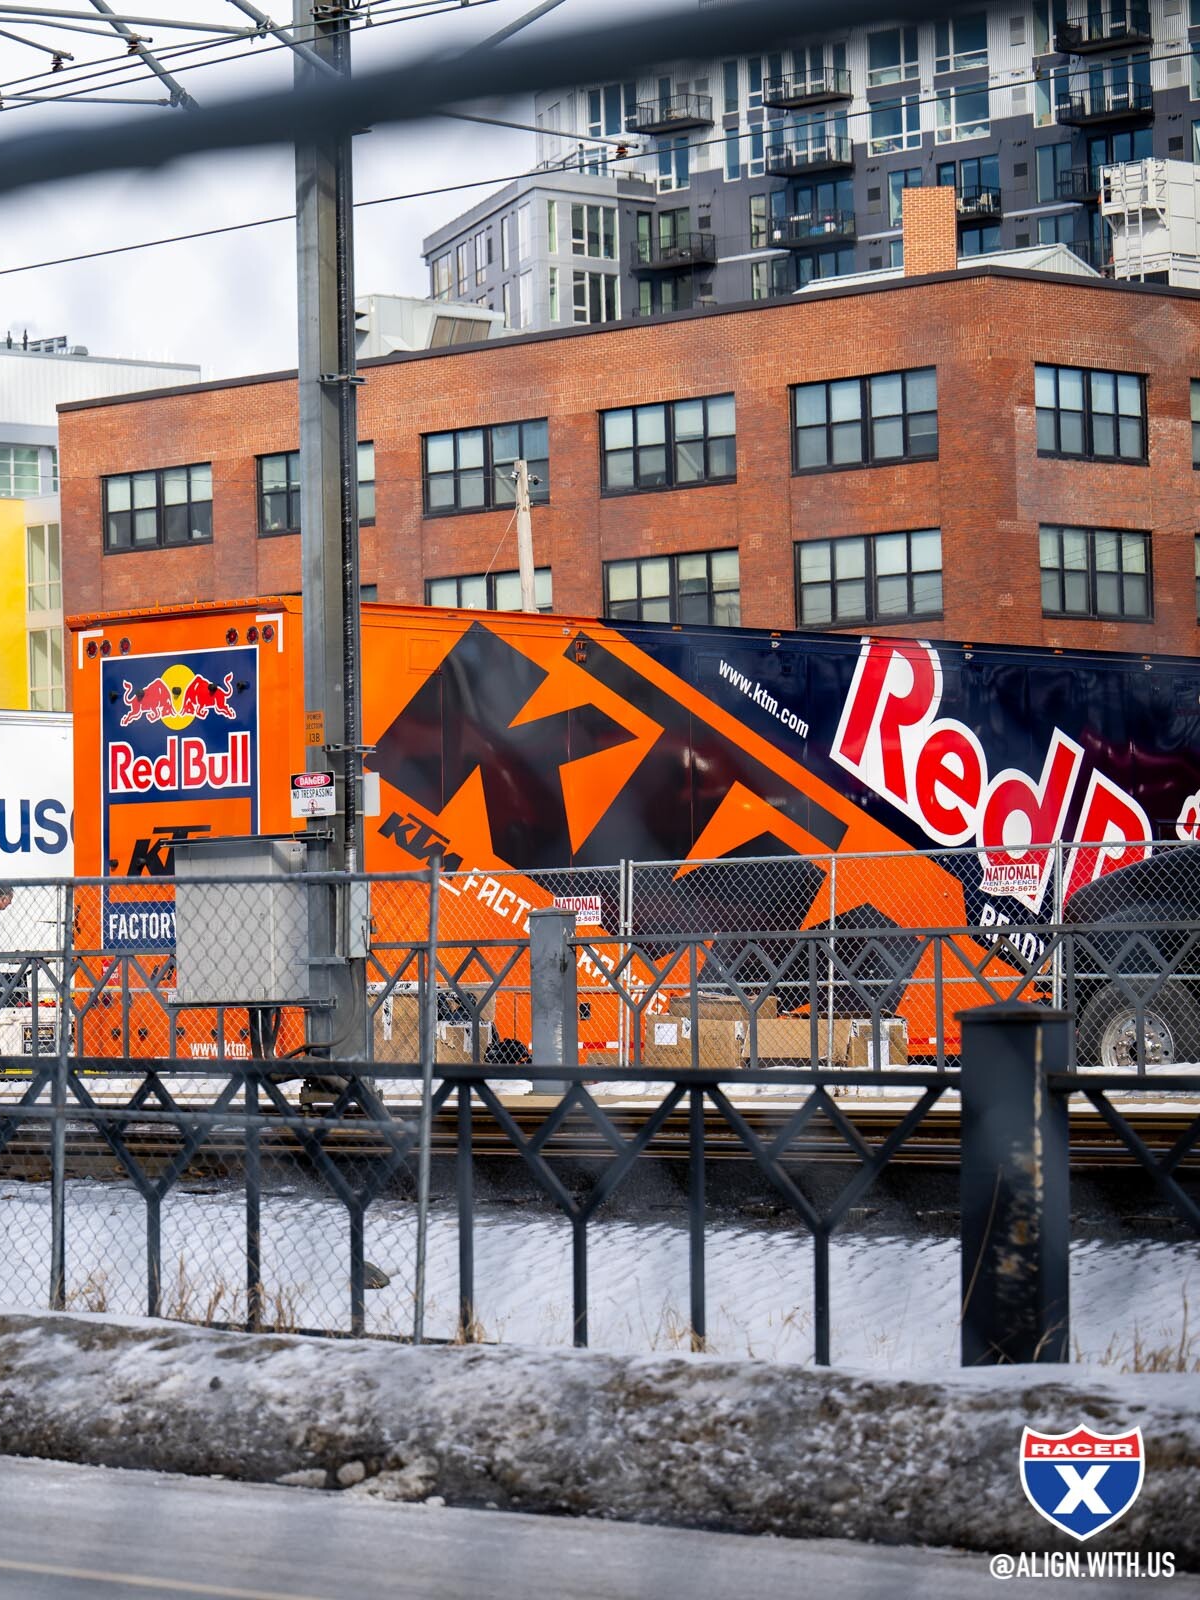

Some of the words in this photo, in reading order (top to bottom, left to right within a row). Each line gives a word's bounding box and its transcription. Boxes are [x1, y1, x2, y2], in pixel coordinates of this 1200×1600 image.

[719, 660, 809, 739] www.ktm.com
[309, 733, 320, 742] 13B
[109, 736, 178, 793] Red
[181, 731, 251, 790] Bull
[299, 776, 325, 786] DANGER
[293, 790, 300, 799] NO
[301, 787, 333, 798] TRESPASSING
[377, 811, 464, 881] KTM
[985, 866, 1038, 881] NATIONAL
[555, 897, 599, 911] NATIONAL
